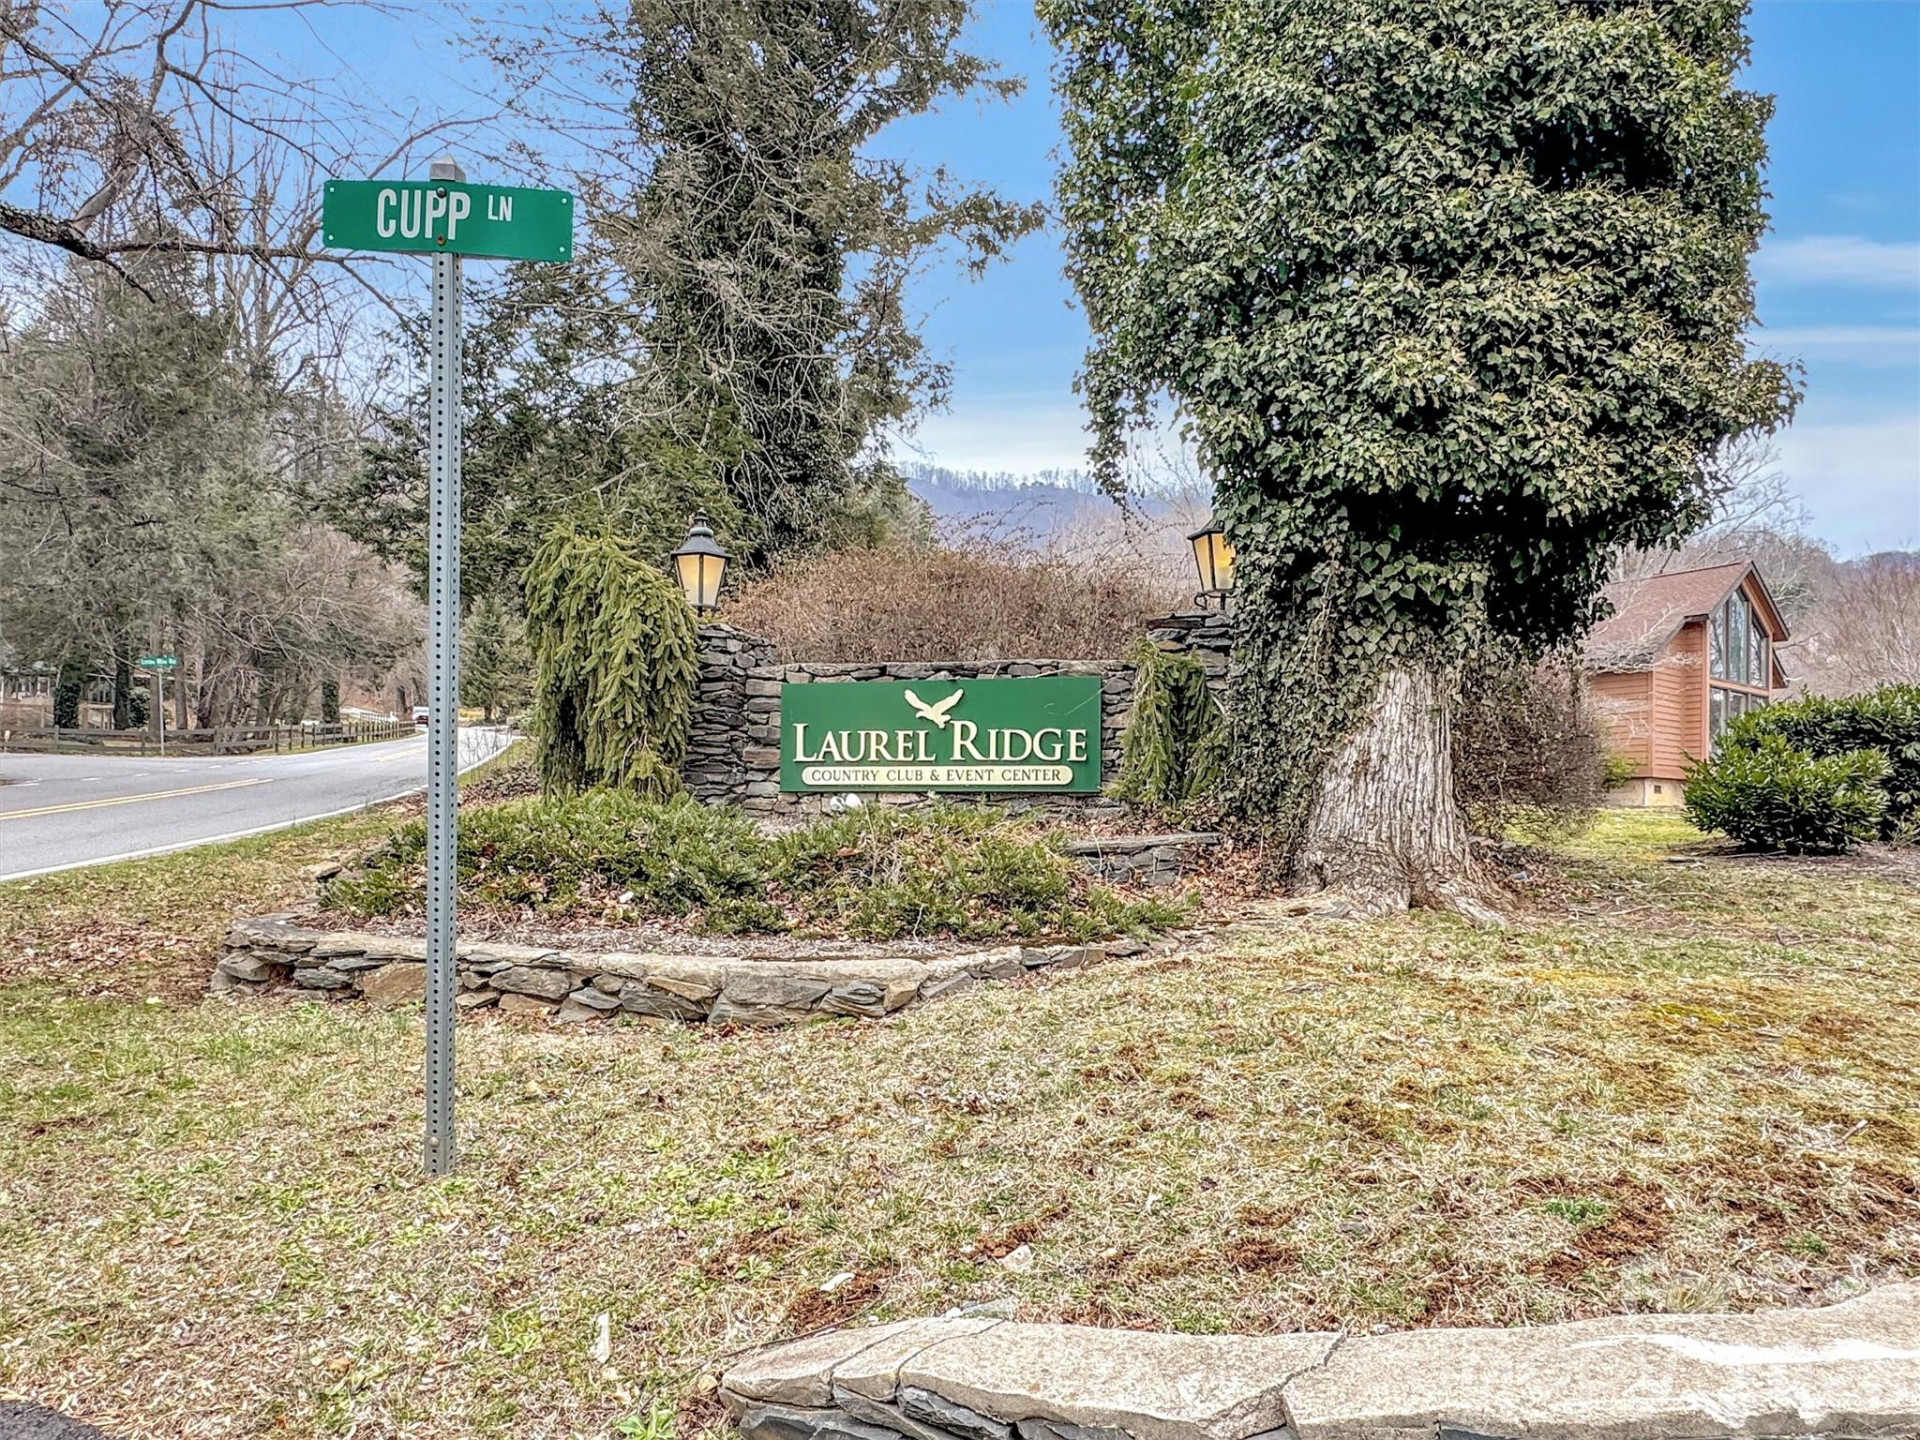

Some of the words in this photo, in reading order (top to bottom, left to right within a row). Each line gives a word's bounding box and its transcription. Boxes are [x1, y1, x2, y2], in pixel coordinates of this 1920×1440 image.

[376, 188, 471, 241] CUPP
[487, 194, 513, 222] LN
[793, 722, 936, 763] LAUREL
[950, 720, 1088, 762] RIDGE
[811, 769, 880, 782] COUNTRY
[886, 769, 924, 782] CLUB
[930, 769, 941, 782] &
[946, 769, 995, 782] EVENT
[1001, 769, 1062, 782] CENTER
